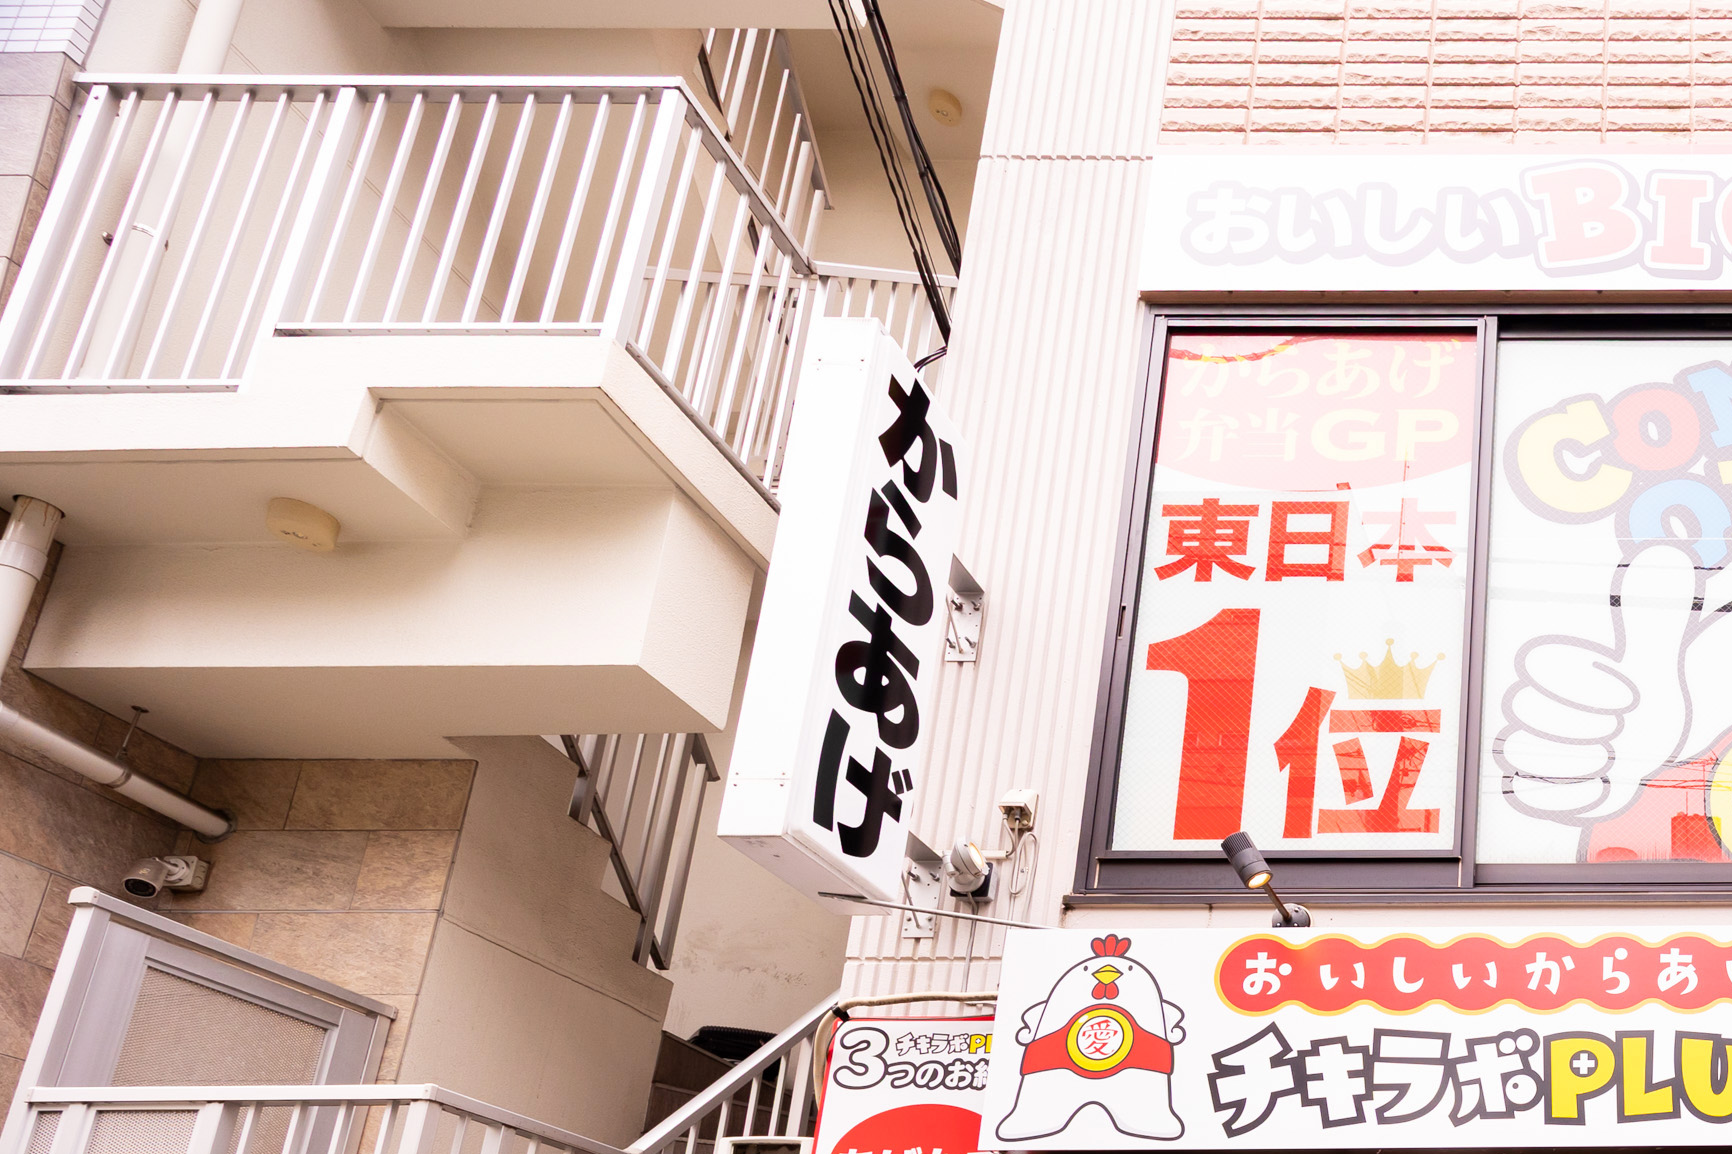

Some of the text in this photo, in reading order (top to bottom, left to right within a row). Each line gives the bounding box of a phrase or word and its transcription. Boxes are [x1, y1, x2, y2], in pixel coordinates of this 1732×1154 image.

[1180, 338, 1463, 399] からあげ
[1173, 406, 1461, 464] 弁当GP
[1153, 498, 1457, 583] 東日本
[812, 373, 958, 858] からあげ
[1145, 607, 1442, 841] 1位
